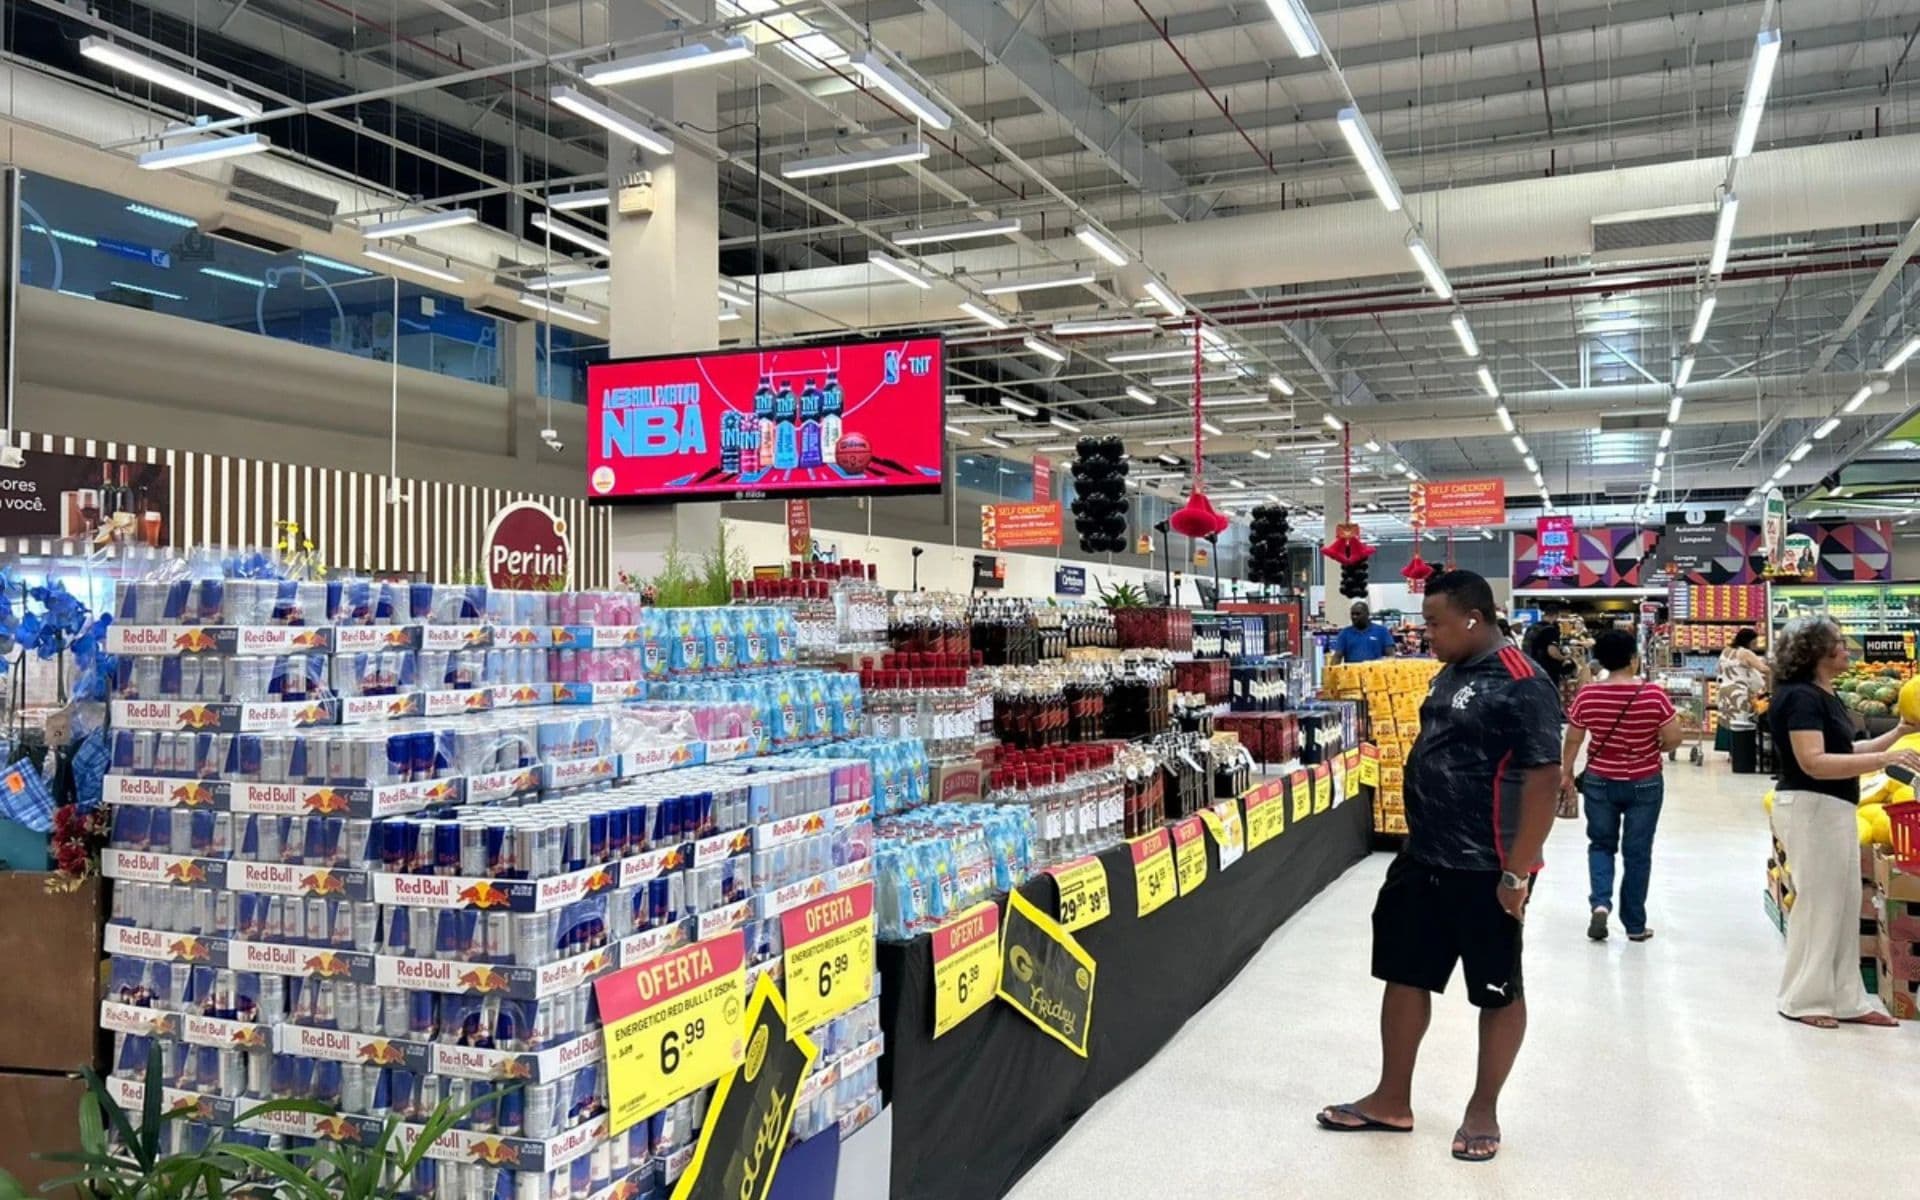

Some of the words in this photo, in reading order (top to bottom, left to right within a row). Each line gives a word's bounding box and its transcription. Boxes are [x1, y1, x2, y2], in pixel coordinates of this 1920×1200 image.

[908, 355, 932, 374] TNT
[755, 395, 773, 409] TNT
[776, 398, 794, 412] TNT
[801, 396, 819, 410] TNT
[602, 405, 707, 459] NBA
[0, 479, 37, 492] ores
[1429, 486, 1448, 495] SELF
[1451, 483, 1496, 493] CHECKOUT
[5, 497, 47, 512] você.
[998, 507, 1016, 516] SELF
[1017, 504, 1056, 514] CHECKOUT
[493, 544, 563, 575] Perini
[123, 629, 144, 643] Red
[146, 629, 167, 643] Bull
[244, 630, 265, 642] Red
[266, 630, 286, 643] Bull
[341, 631, 358, 642] Red
[358, 629, 376, 641] Bull
[127, 704, 148, 717] Red
[150, 704, 170, 718] Bull
[348, 701, 365, 714] Red
[366, 700, 383, 713] Bull
[120, 780, 141, 794] Red
[143, 780, 164, 794] Bull
[248, 786, 270, 802] Red
[272, 787, 296, 803] Bull
[118, 854, 138, 869] Red
[139, 856, 159, 870] Bull
[246, 865, 268, 880] Red
[270, 867, 293, 883] Bull
[395, 878, 418, 895] Red
[420, 880, 449, 896] Bull
[542, 883, 559, 897] Red
[560, 879, 577, 894] Bull
[805, 895, 854, 933] OFERTA
[119, 929, 139, 945] Red
[140, 931, 162, 948] Bull
[949, 915, 985, 949] OFERTA
[248, 946, 270, 961] Red
[272, 948, 296, 964] Bull
[791, 943, 824, 964] ENERGETICO
[397, 960, 421, 977] Red
[422, 962, 450, 979] Bull
[542, 968, 560, 983] Red
[560, 962, 577, 978] Bull
[637, 947, 714, 1001] OFERTA
[818, 953, 849, 997] 6,99
[615, 1008, 666, 1042] ENERGETICO
[667, 1003, 684, 1019] RED
[685, 995, 703, 1011] BULL
[714, 979, 738, 999] 250ML
[190, 1021, 206, 1034] Red
[208, 1023, 226, 1037] Bull
[302, 1031, 325, 1046] Red
[327, 1033, 350, 1049] Bull
[660, 1017, 705, 1075] 6,99
[439, 1051, 460, 1065] Red
[462, 1053, 483, 1068] Bull
[560, 1044, 580, 1062] Red
[551, 1139, 568, 1157] Red
[569, 1130, 586, 1149] Bull
